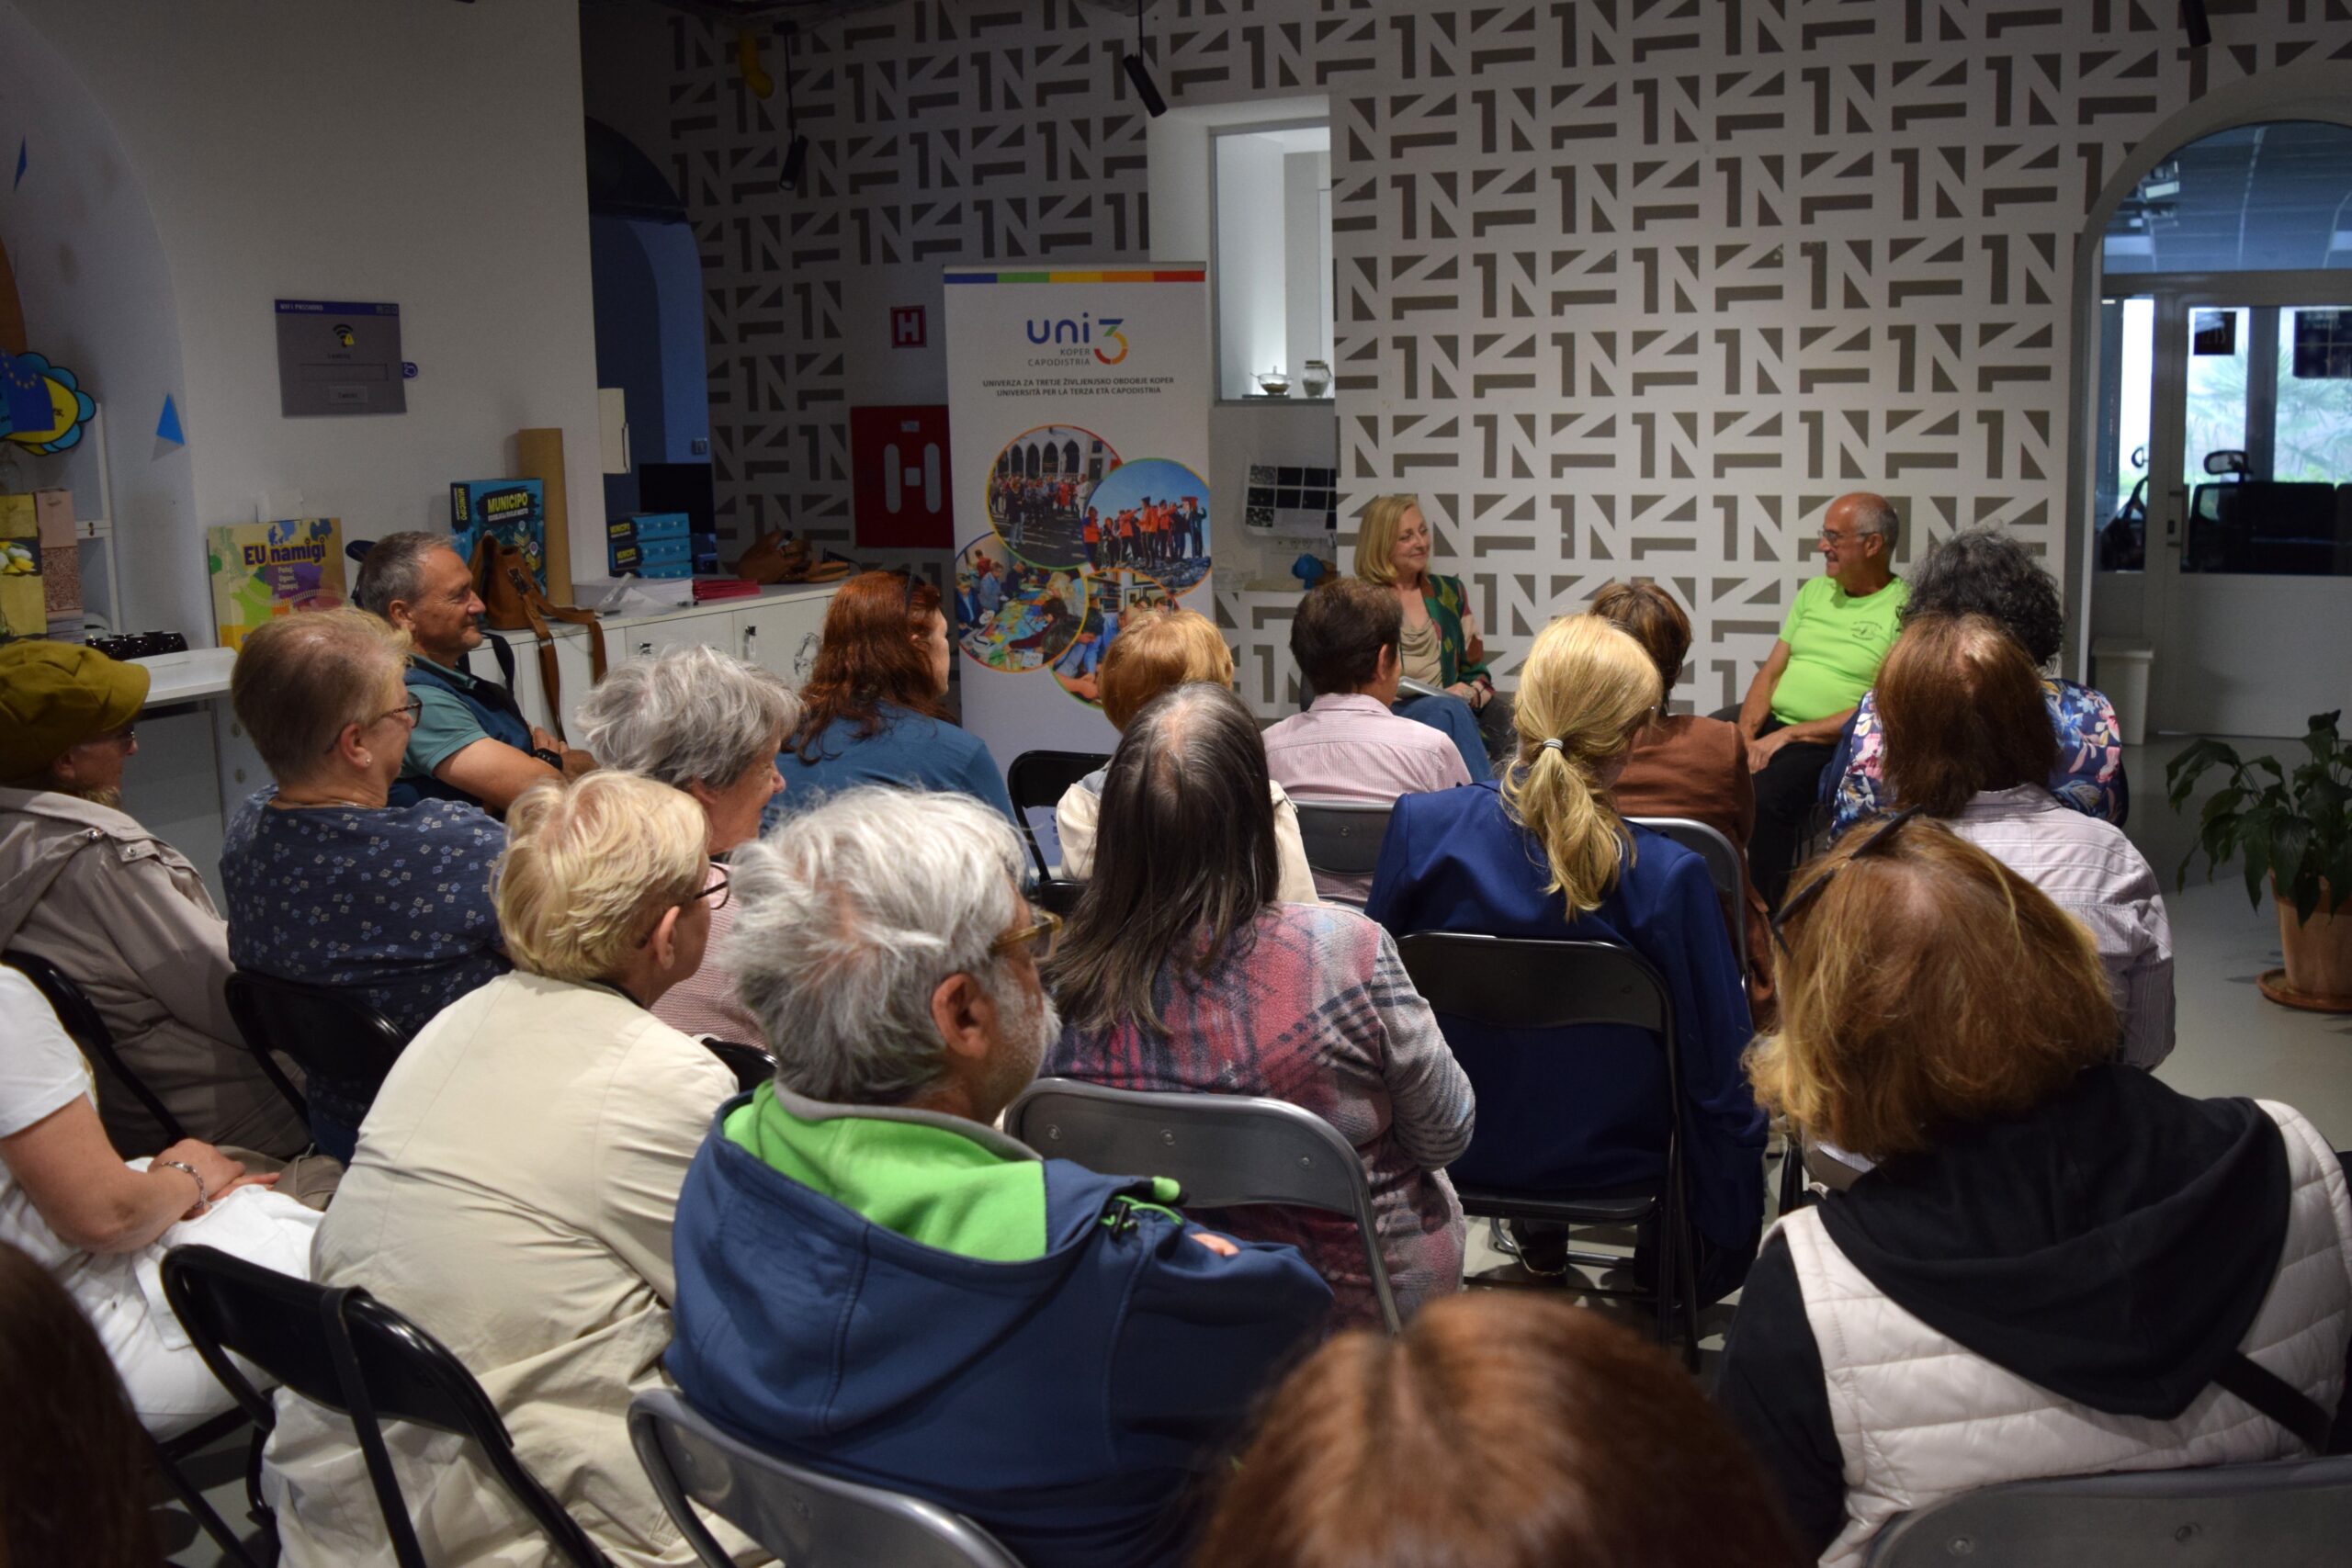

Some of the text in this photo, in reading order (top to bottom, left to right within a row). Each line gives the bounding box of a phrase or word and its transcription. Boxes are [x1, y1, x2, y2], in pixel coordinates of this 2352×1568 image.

[897, 311, 921, 343] H
[1059, 348, 1091, 356] KOPER
[1027, 358, 1091, 367] CAPODISTRIA
[982, 379, 1022, 388] UNIVERZA
[1035, 378, 1061, 387] TRETJE
[1063, 378, 1112, 386] ŽIVLJENJSKO
[1111, 387, 1161, 395] CAPODISTRIA
[487, 491, 528, 514] MUNICIPO
[243, 536, 326, 566] EU namigi
